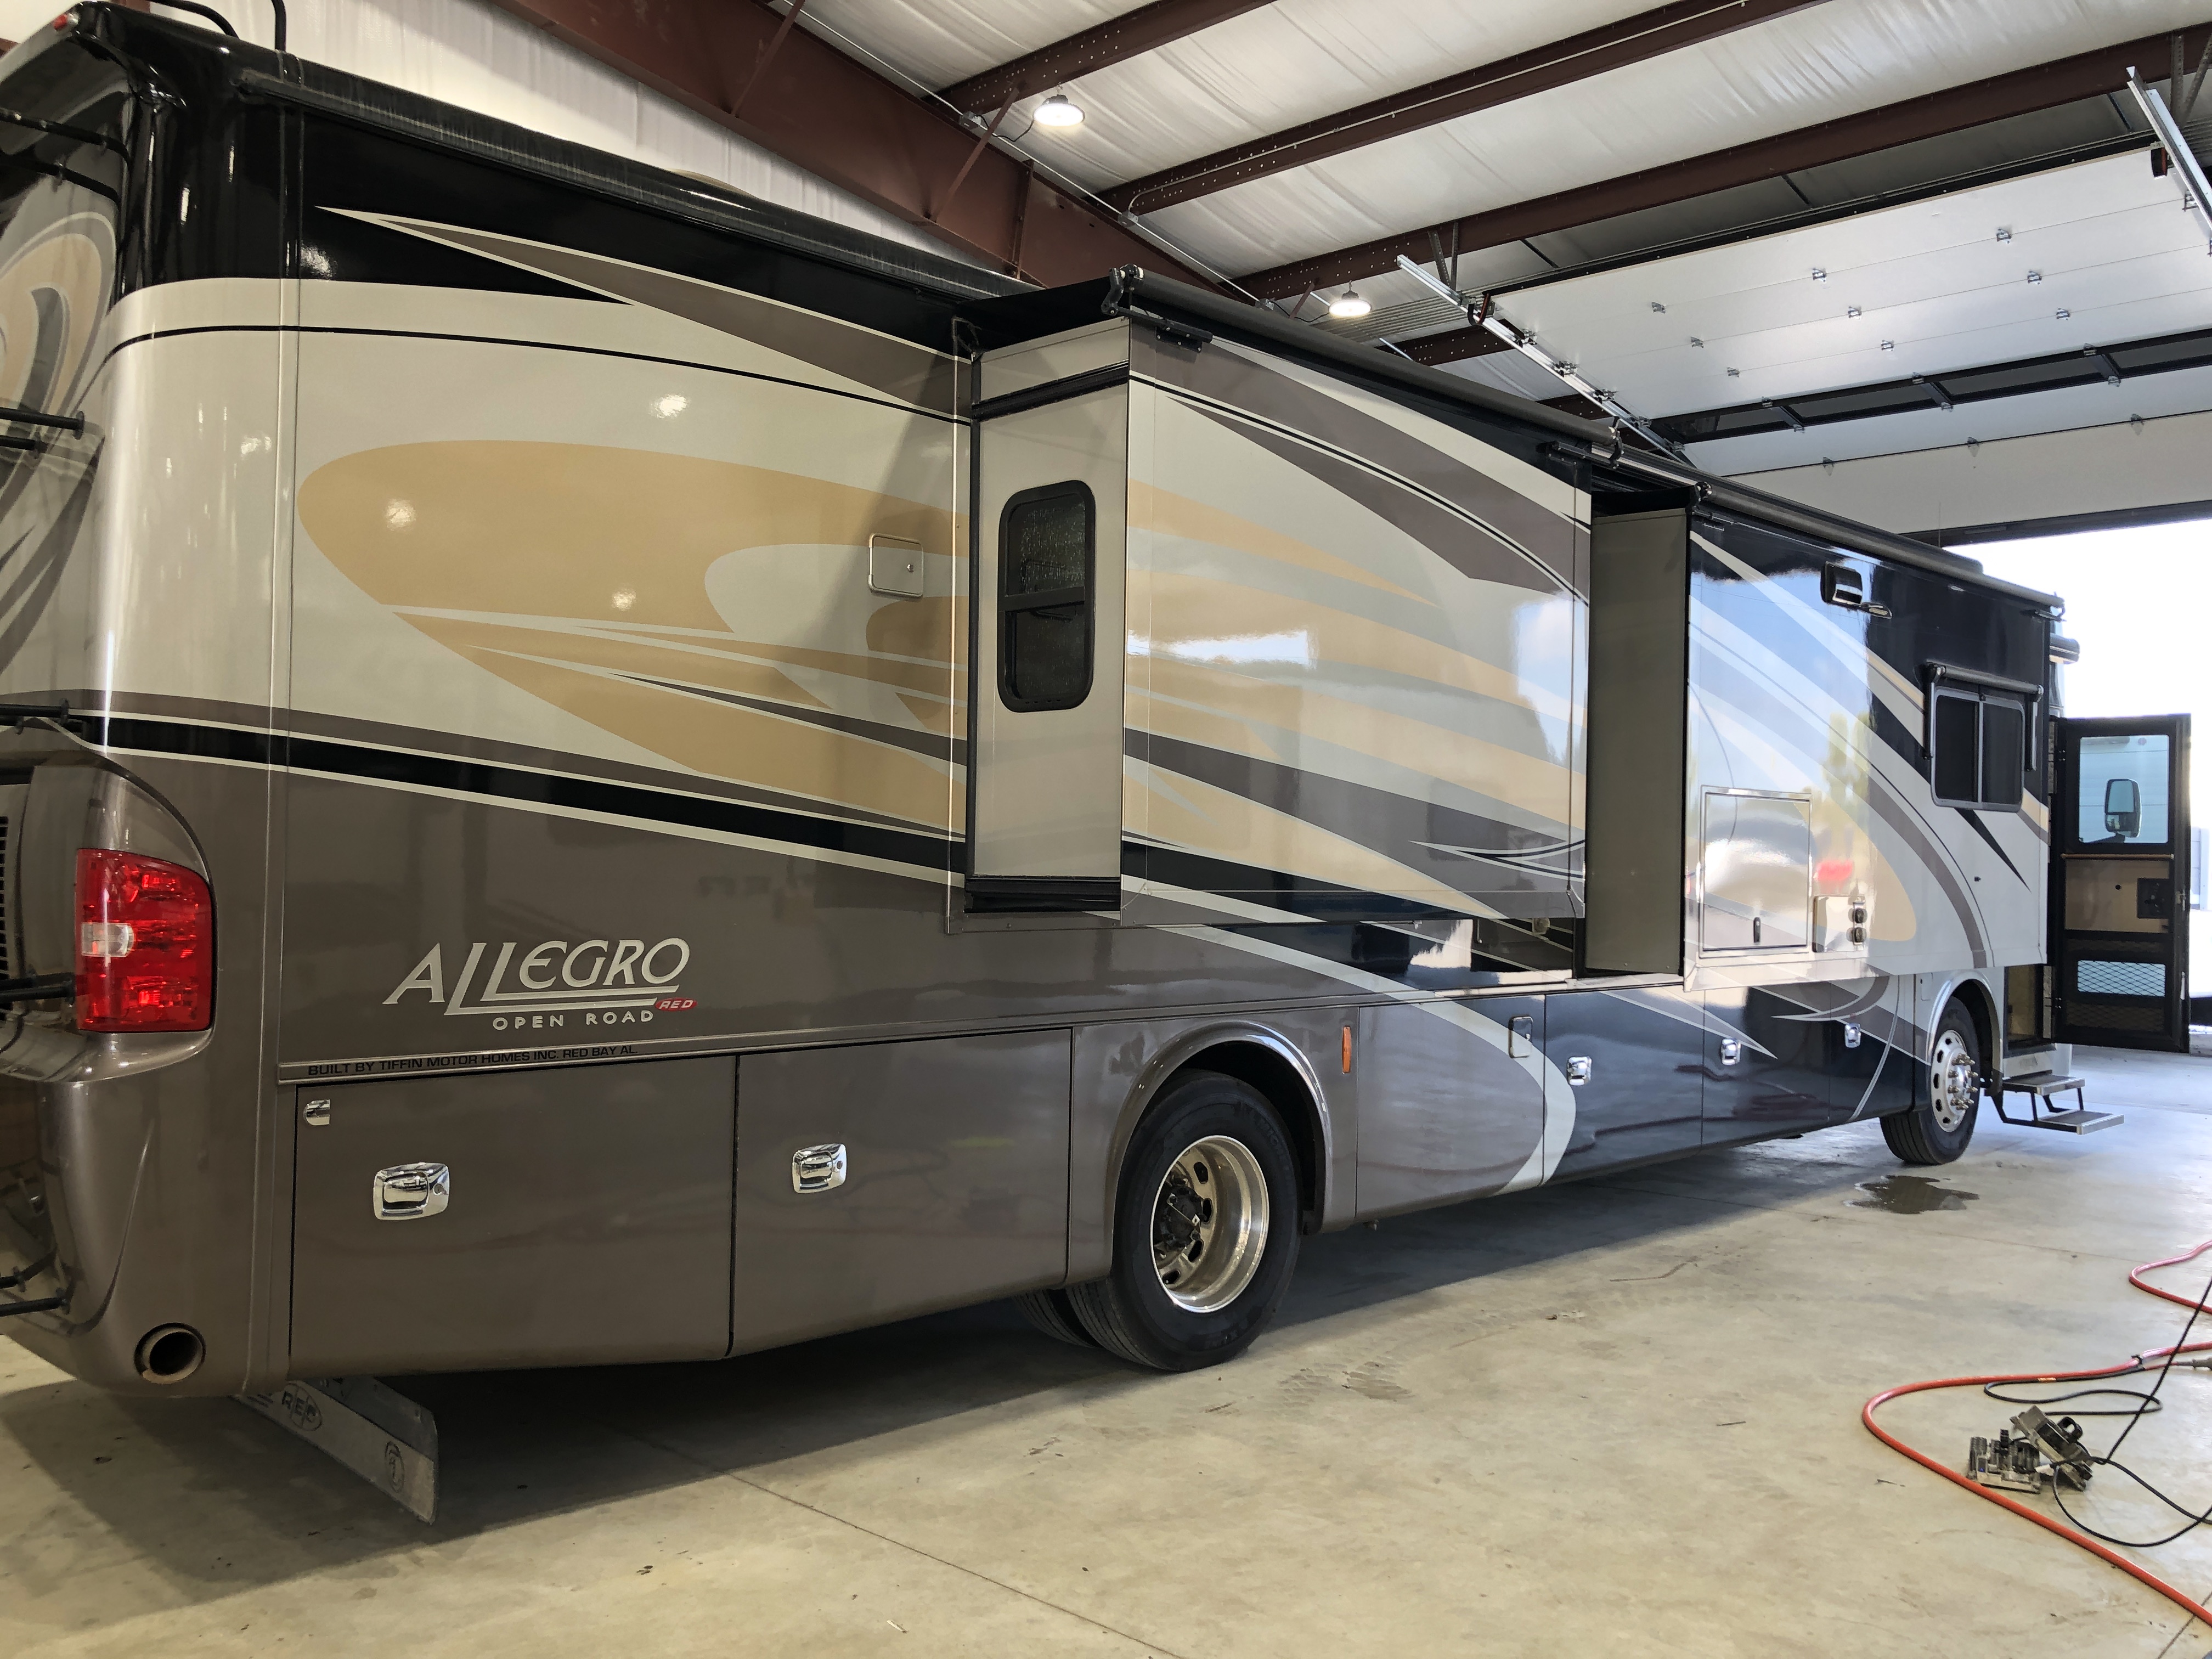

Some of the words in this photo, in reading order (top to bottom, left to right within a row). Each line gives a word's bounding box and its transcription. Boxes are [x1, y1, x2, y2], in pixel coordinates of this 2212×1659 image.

[382, 938, 691, 1015] ALLEGRO
[659, 1000, 693, 1009] RED
[493, 1014, 564, 1030] OPEN
[586, 1010, 654, 1026] ROAD
[308, 1063, 352, 1075] BUILT
[356, 1061, 376, 1073] BY
[379, 1058, 423, 1070] TIFFIN
[427, 1054, 477, 1067] MOTOR
[481, 1051, 531, 1063] HOMES
[534, 1049, 559, 1060] INC.
[563, 1047, 588, 1058] RED
[592, 1046, 618, 1057] BAY
[620, 1045, 638, 1054] AL.
